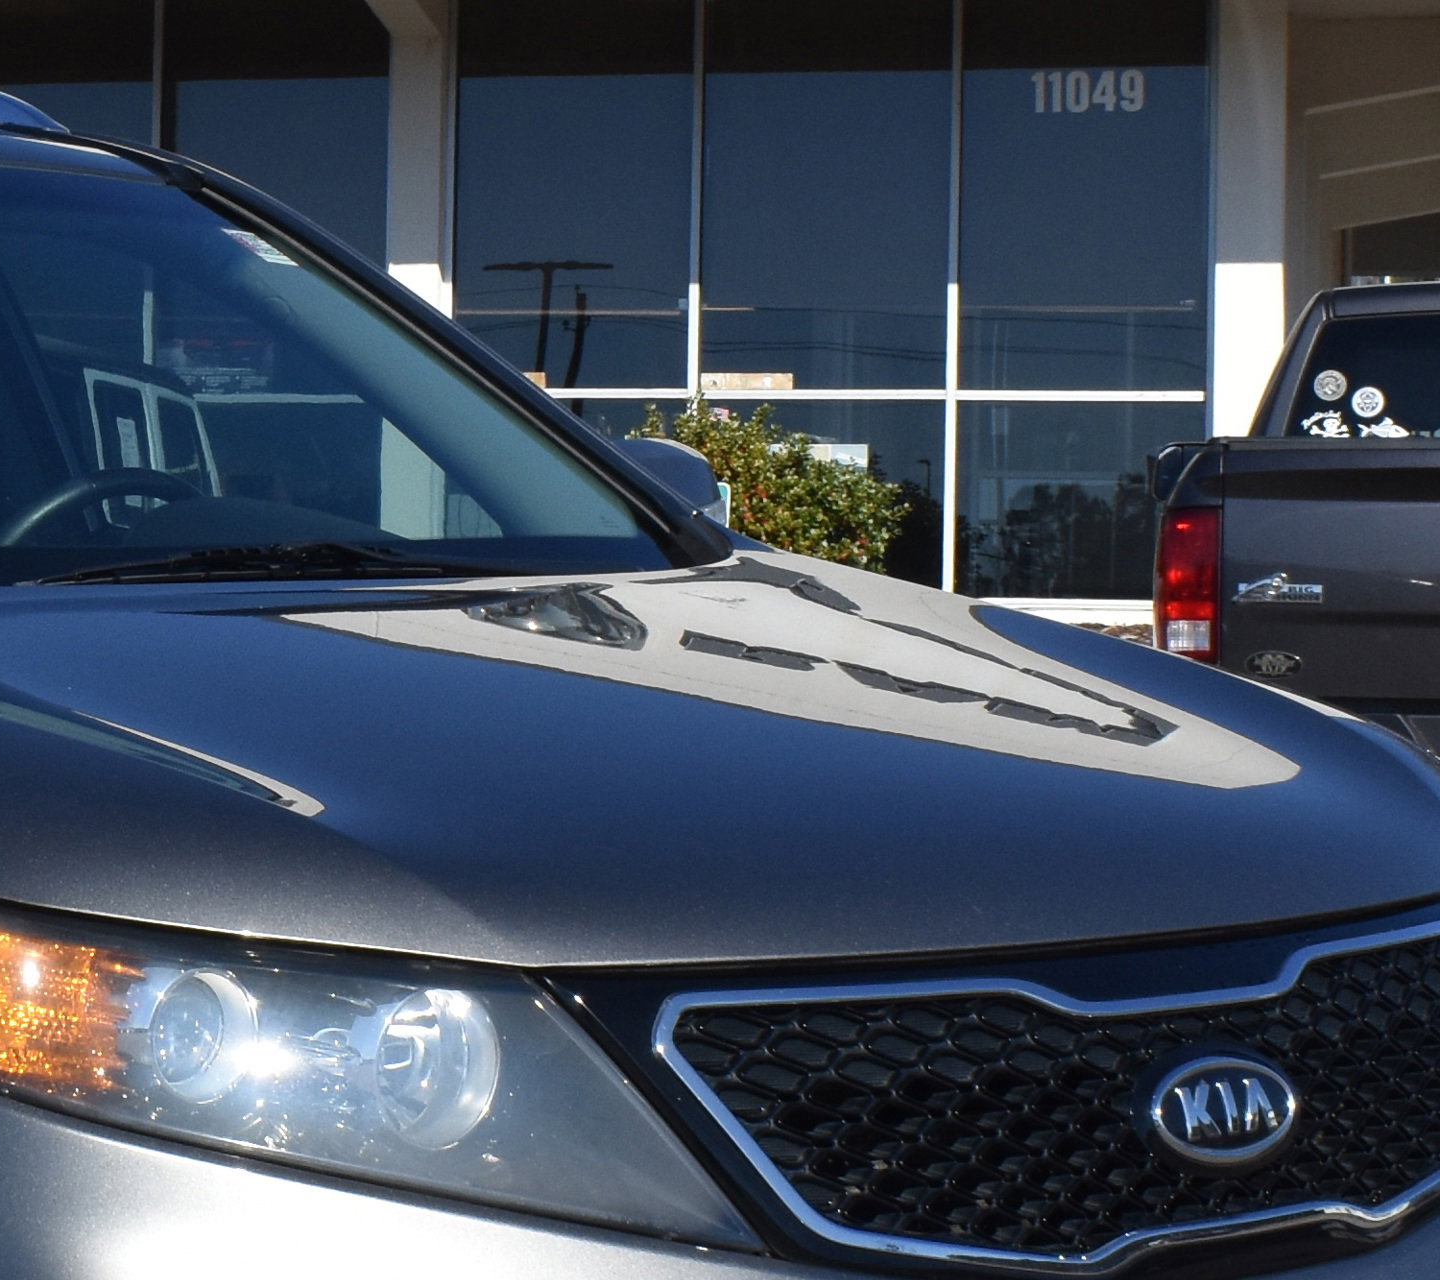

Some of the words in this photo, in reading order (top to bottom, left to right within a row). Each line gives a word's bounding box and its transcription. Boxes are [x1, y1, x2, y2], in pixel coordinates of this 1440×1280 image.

[1031, 69, 1144, 113] 11049
[1288, 585, 1314, 593] BIG
[1173, 1077, 1279, 1141] KIA
